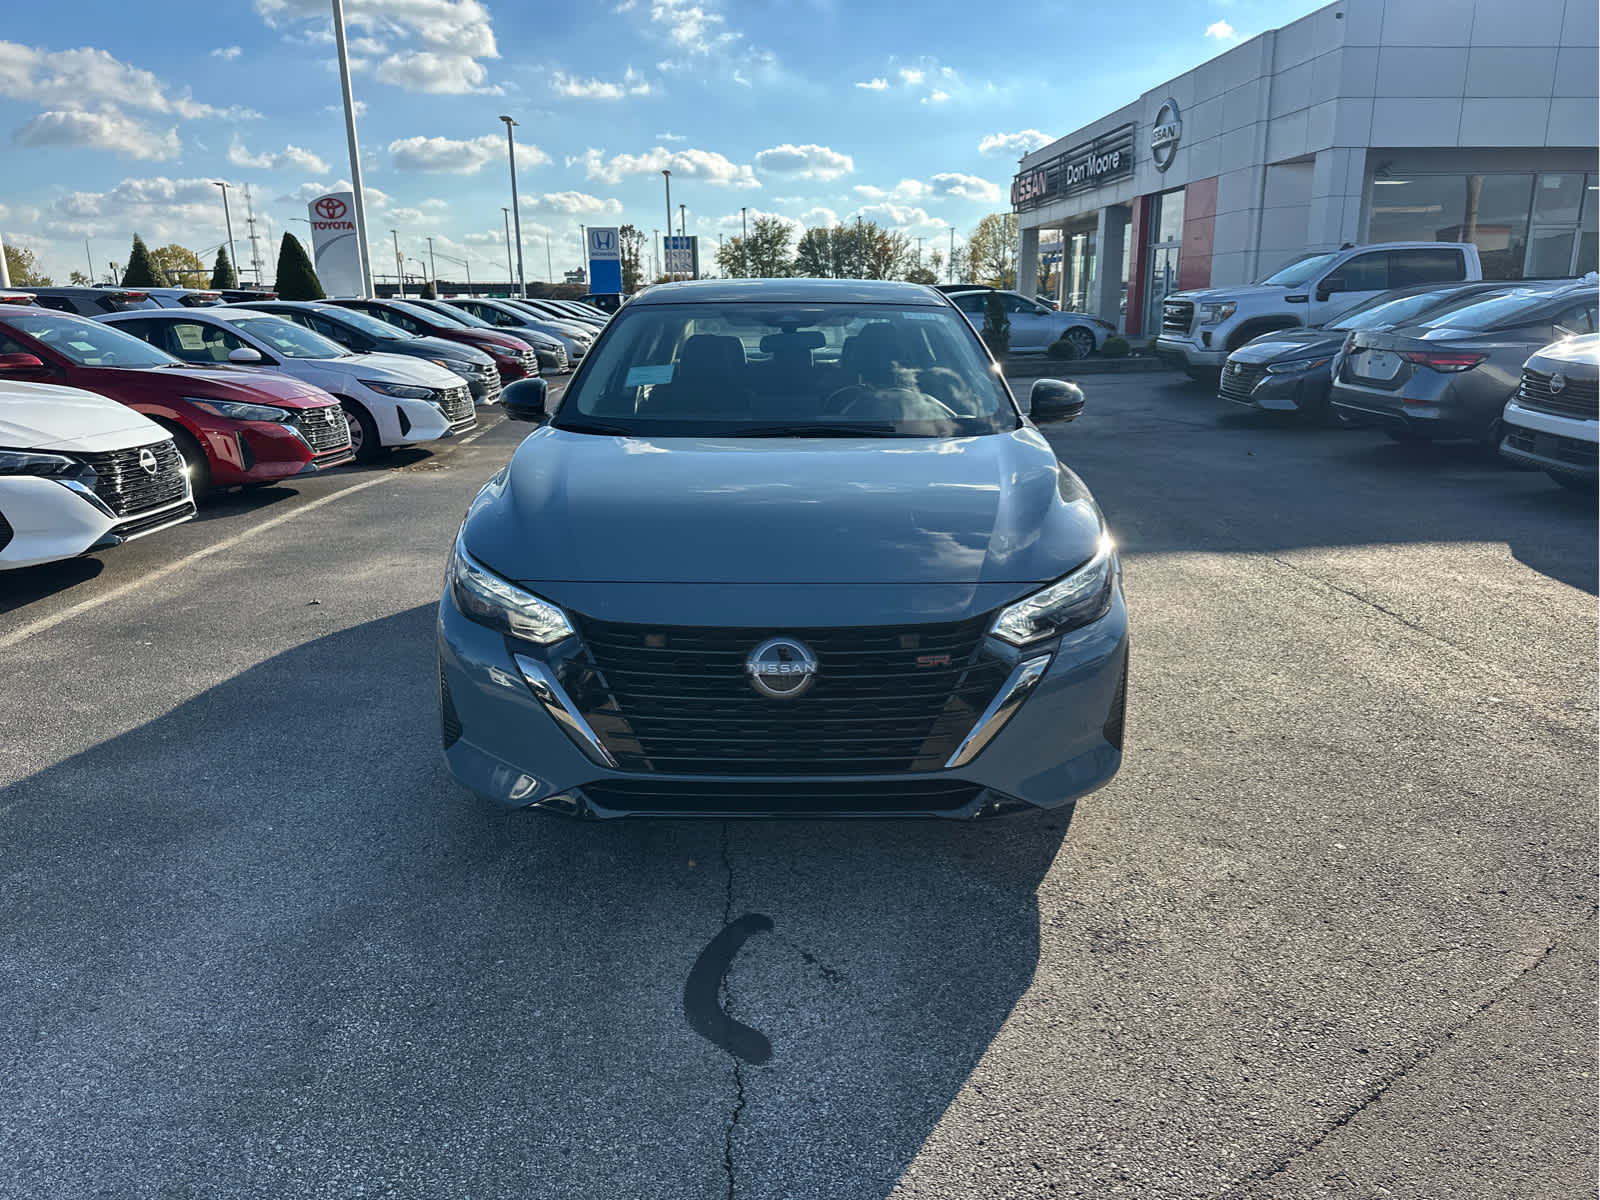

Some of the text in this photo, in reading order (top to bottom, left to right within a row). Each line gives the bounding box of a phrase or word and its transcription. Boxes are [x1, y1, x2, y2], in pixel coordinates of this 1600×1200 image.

[1011, 151, 1120, 205] NISSAN Don Moore
[311, 221, 355, 231] TOYOTA
[916, 655, 950, 667] SR
[749, 663, 816, 673] NISSAN
